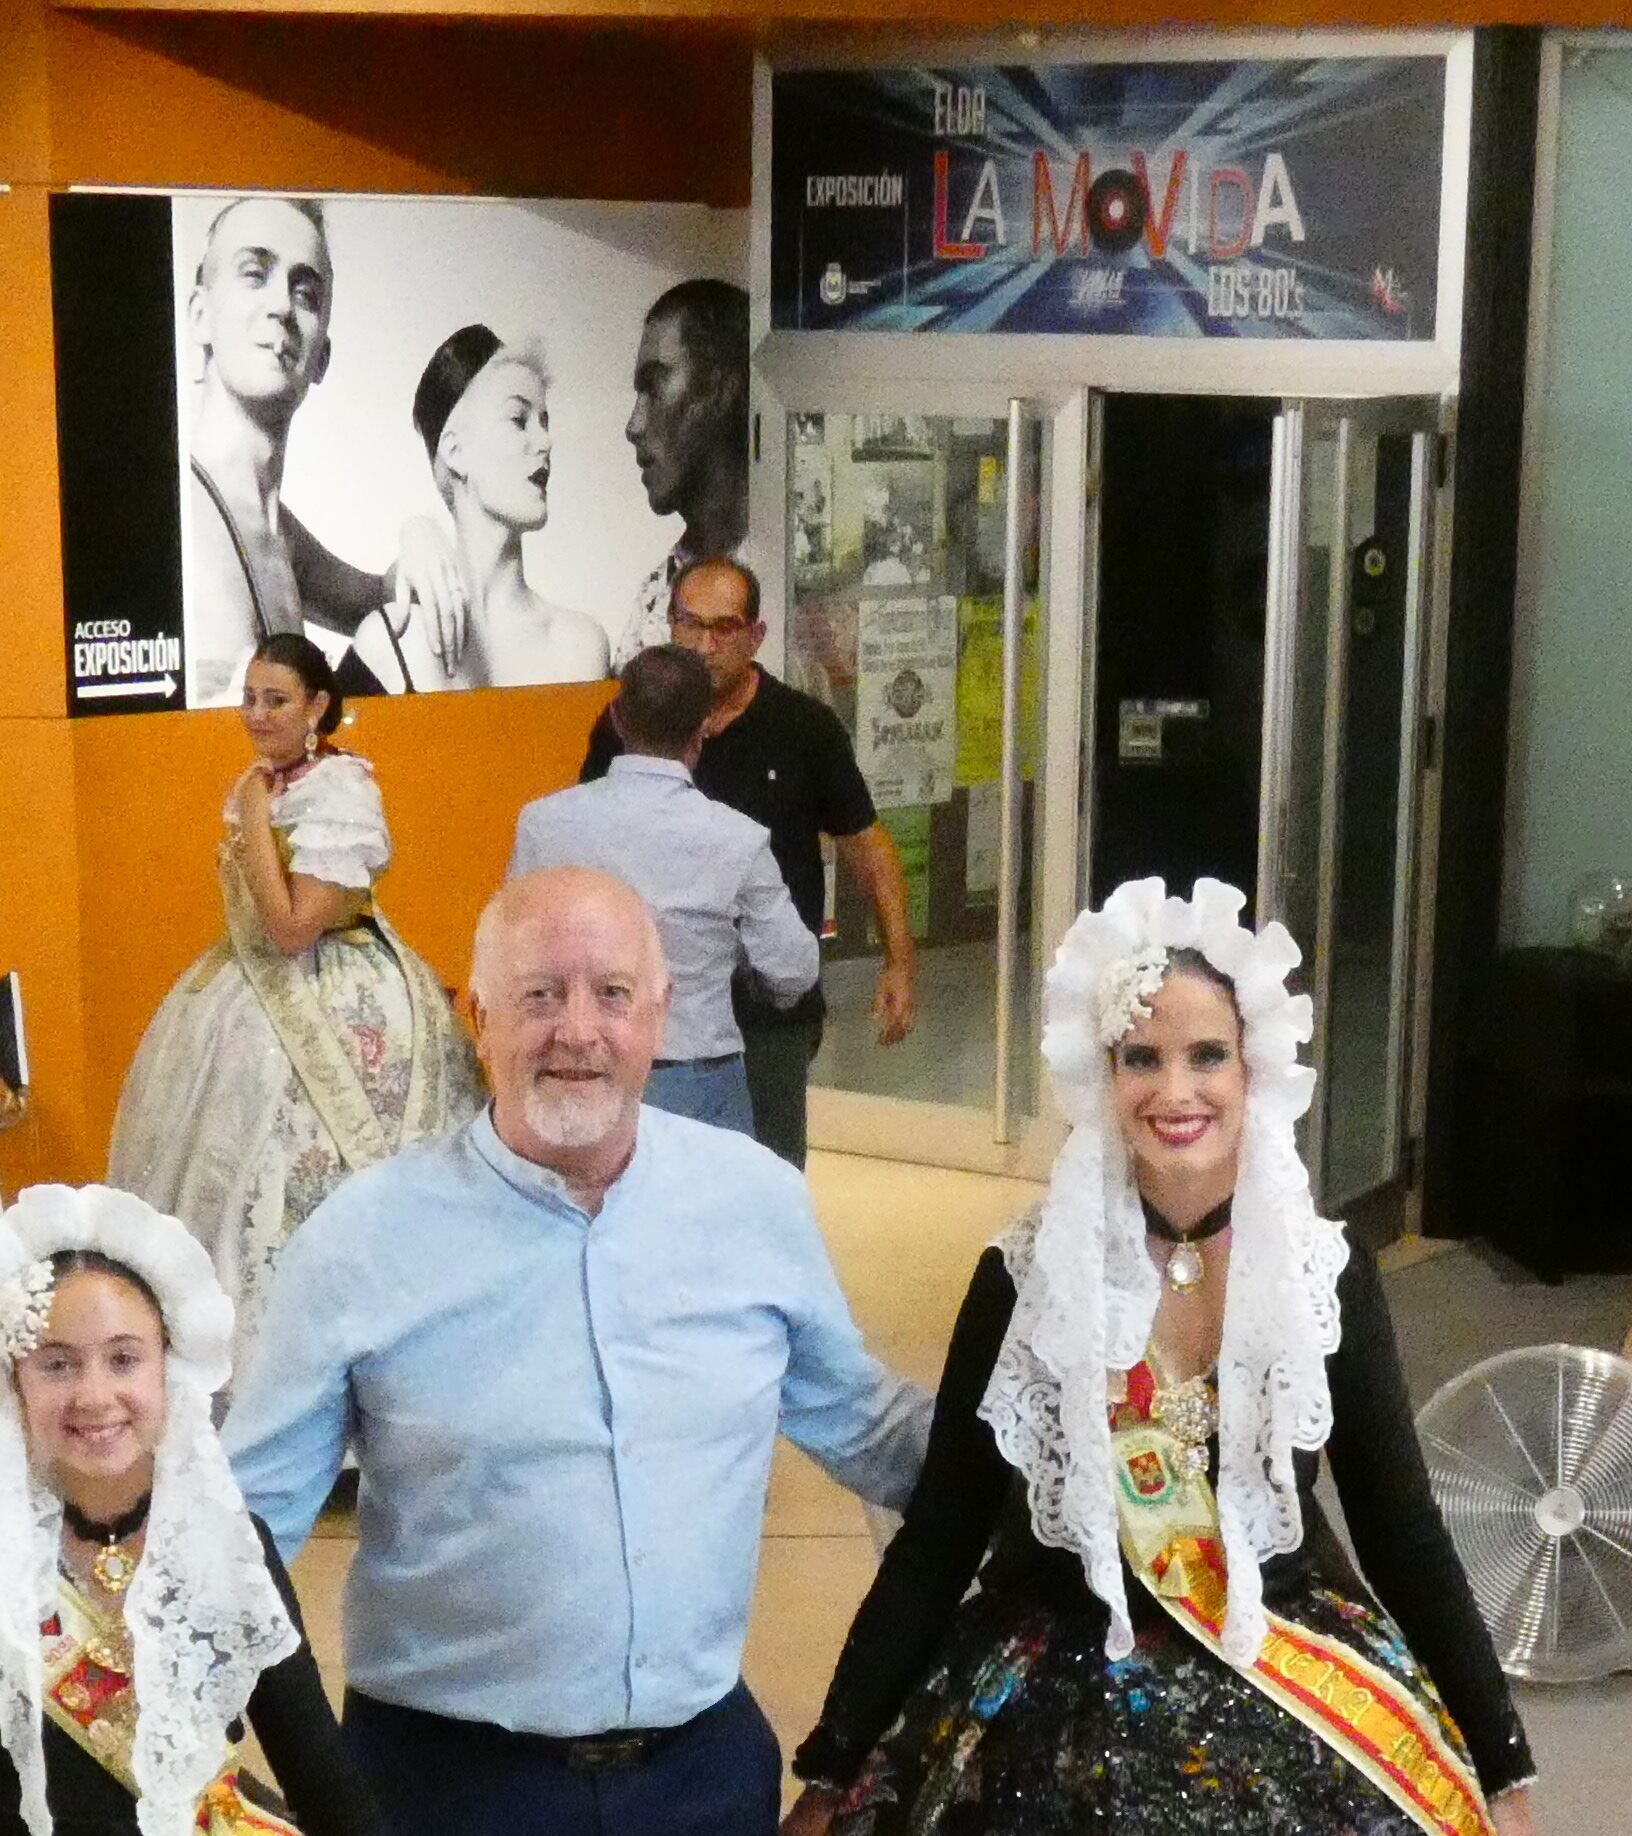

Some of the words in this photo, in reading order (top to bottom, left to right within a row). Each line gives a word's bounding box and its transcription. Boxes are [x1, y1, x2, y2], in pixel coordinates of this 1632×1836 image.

[934, 84, 986, 135] ELDA
[806, 169, 904, 207] EXPOSICIÓN
[933, 150, 1007, 259] LA
[1031, 150, 1305, 260] MOVIDA
[1206, 266, 1250, 318] LOS
[74, 619, 131, 640] ACCESO
[74, 632, 181, 677] EXPOSICIÓN
